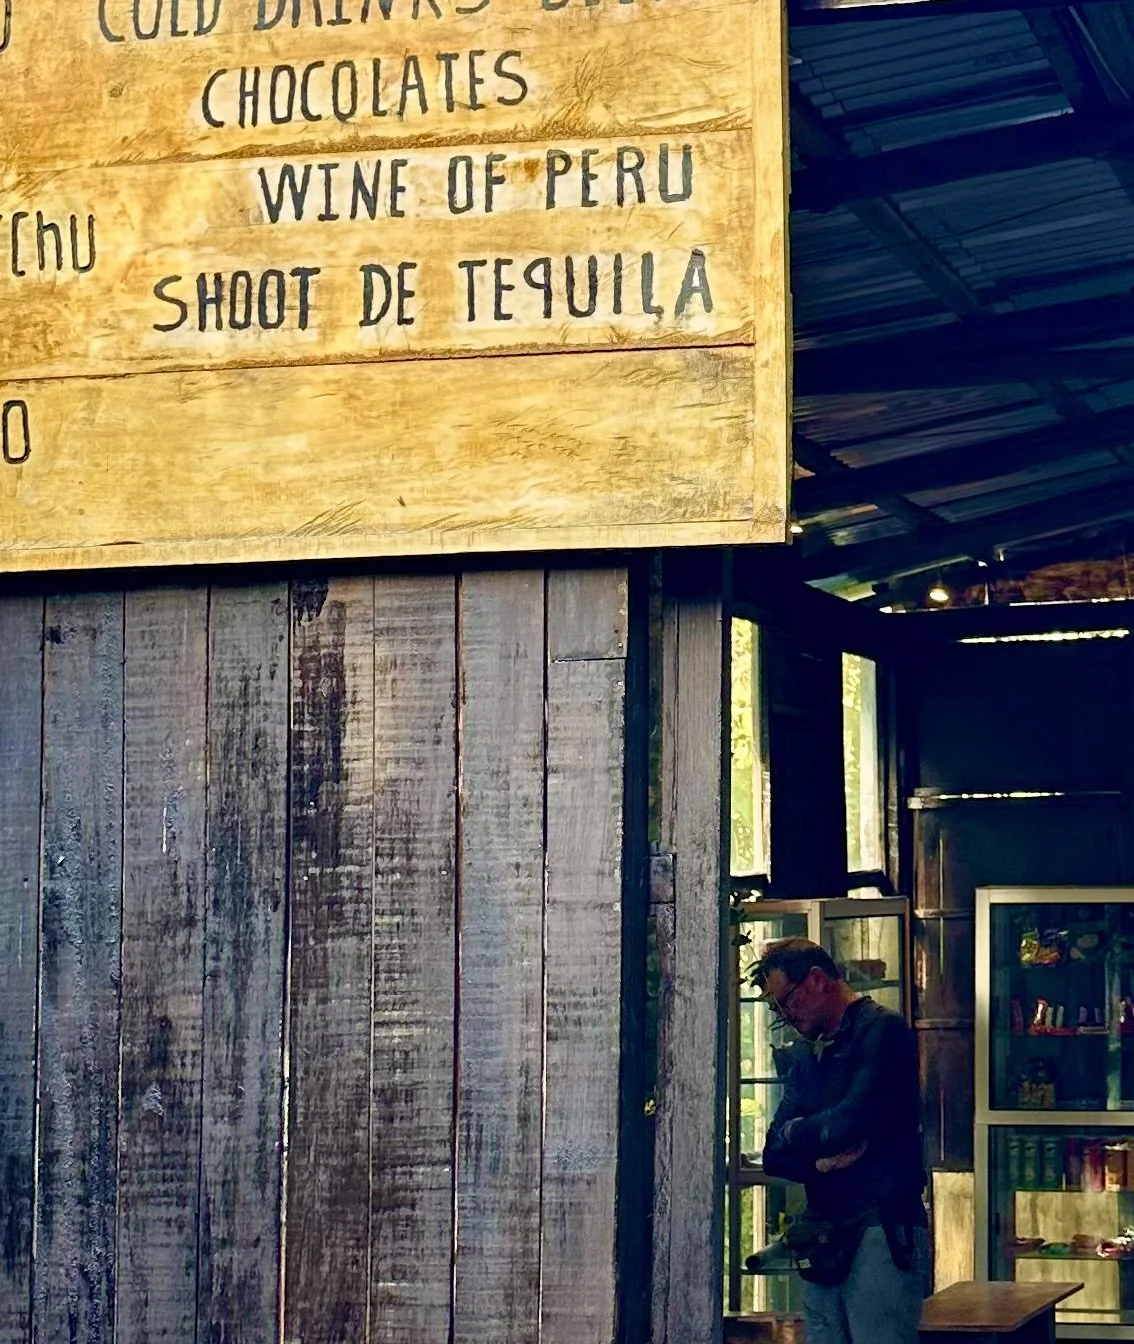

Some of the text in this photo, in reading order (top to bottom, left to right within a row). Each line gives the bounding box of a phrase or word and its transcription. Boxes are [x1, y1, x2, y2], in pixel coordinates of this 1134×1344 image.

[201, 49, 530, 129] CHOCOLATES
[257, 141, 696, 226] WINE OF PERU
[152, 266, 321, 333] SHOOT
[358, 260, 418, 330] DE
